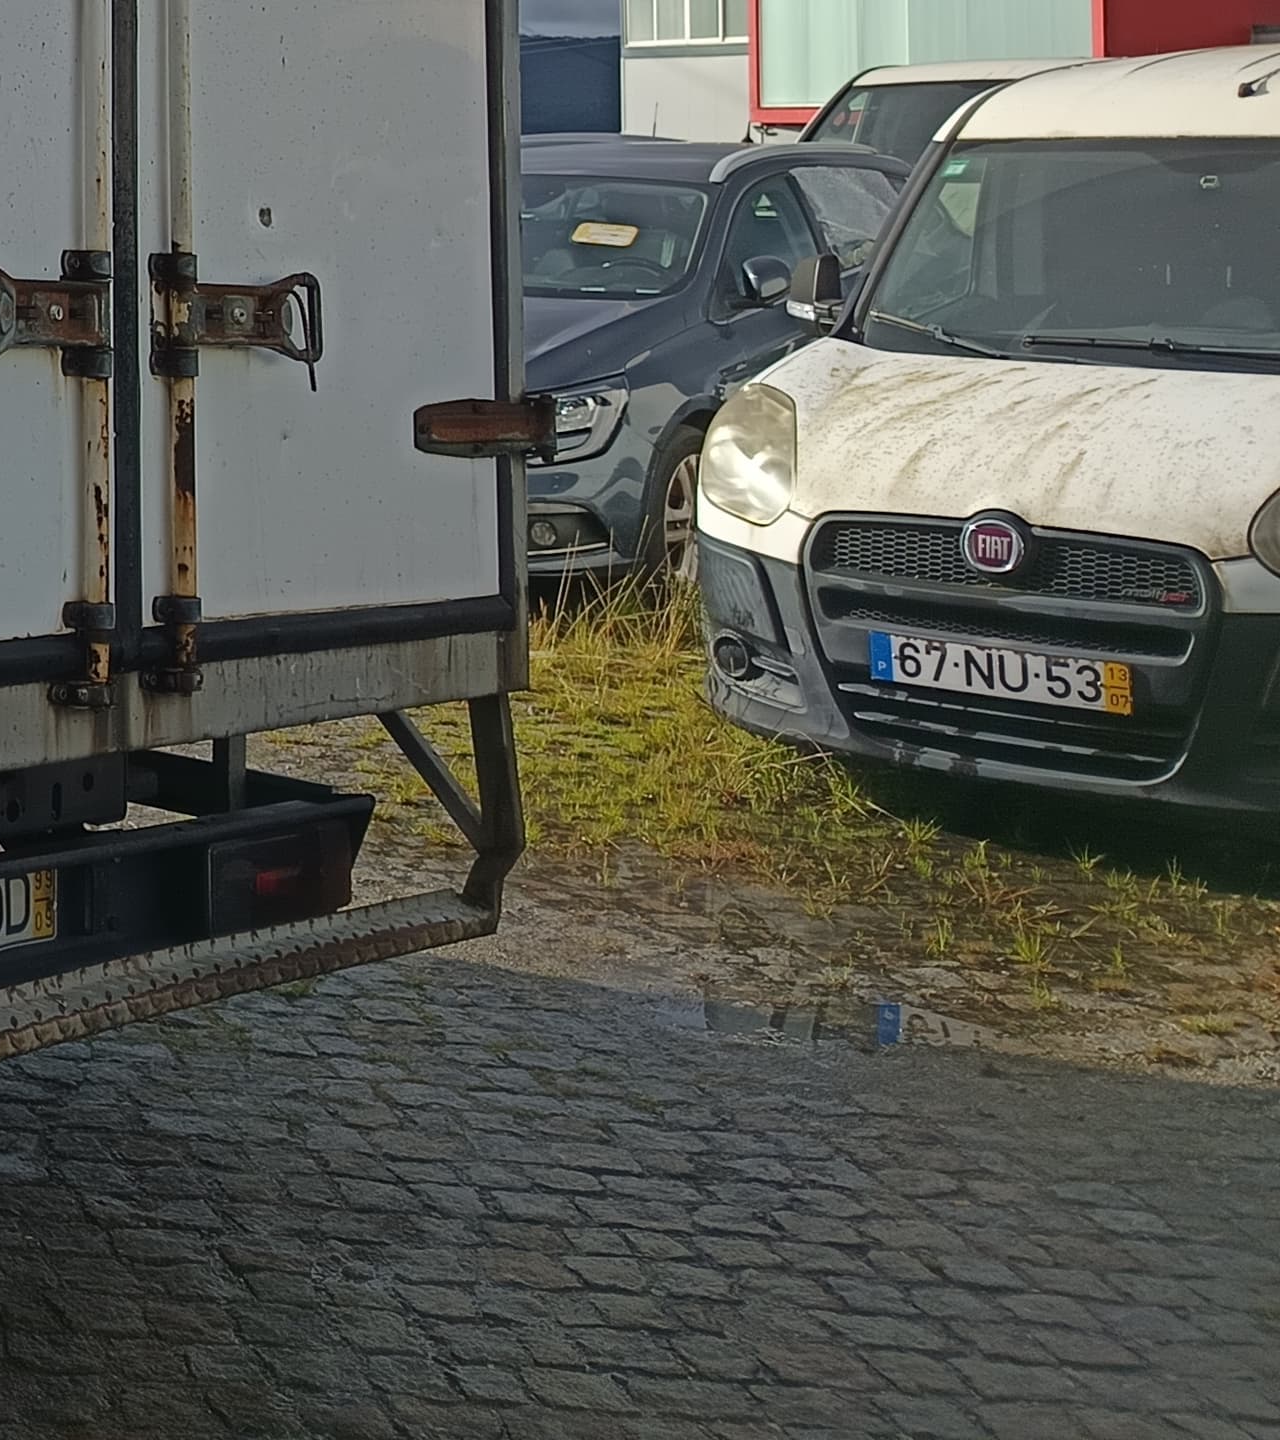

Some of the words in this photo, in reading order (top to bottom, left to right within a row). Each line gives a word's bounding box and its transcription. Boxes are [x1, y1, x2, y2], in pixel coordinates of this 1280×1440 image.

[976, 533, 1012, 561] FIAT
[877, 660, 887, 671] P
[1108, 662, 1127, 681] 13
[1109, 693, 1129, 708] 07
[34, 906, 54, 932] 09
